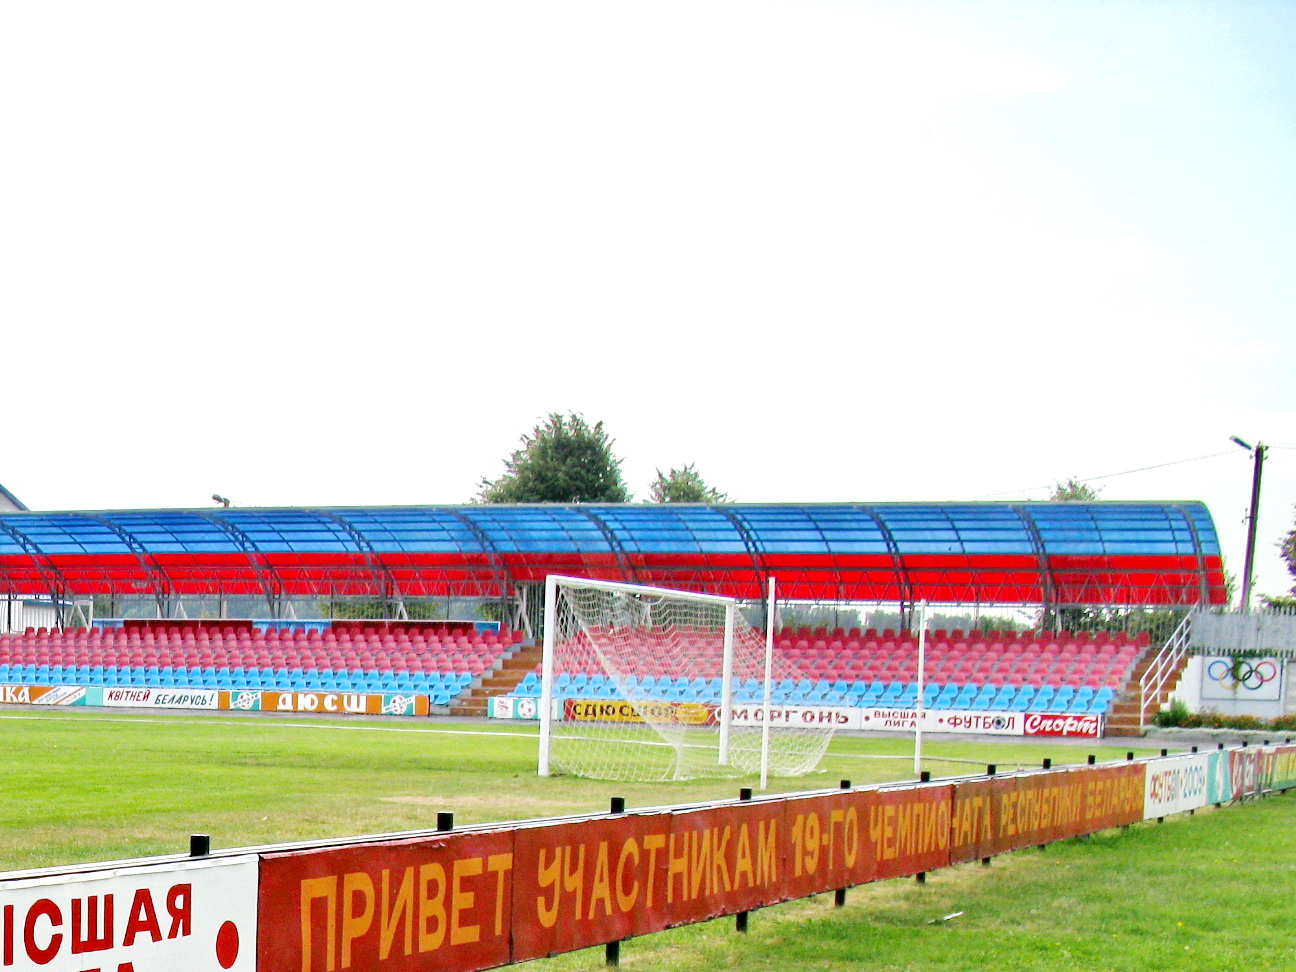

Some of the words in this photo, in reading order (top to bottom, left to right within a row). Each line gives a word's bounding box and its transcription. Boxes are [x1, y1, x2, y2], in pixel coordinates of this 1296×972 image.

[154, 693, 215, 707] БЕЛАРУСЬ!
[277, 693, 367, 712] ДЮСШ
[884, 720, 917, 728] ЛИГА
[947, 715, 1015, 731] ФУТБОЛ
[1025, 714, 1099, 736] Спорт
[537, 817, 778, 928] УЧАСТНИКАМ
[791, 807, 858, 877] 19-ГО
[869, 796, 991, 861] ЧЕМПИОНАТА
[999, 783, 1082, 838] РЕСПУБЛИКИ
